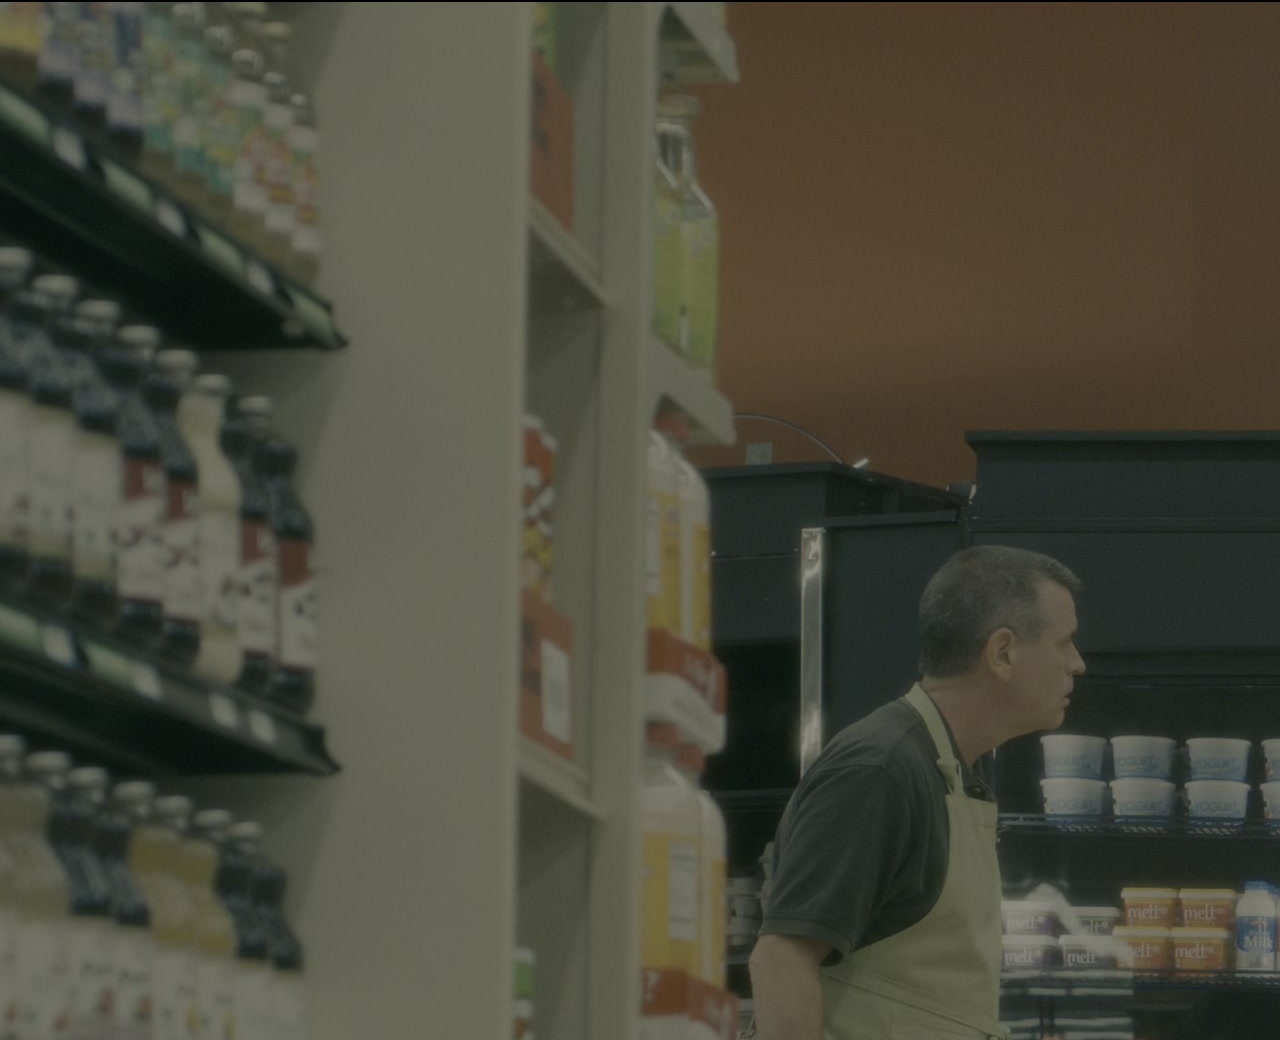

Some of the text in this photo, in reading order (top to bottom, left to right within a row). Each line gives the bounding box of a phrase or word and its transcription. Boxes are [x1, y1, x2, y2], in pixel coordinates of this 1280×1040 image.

[1128, 904, 1160, 920] melt
[1184, 904, 1216, 920] melt
[1245, 935, 1273, 950] Milk
[1005, 948, 1034, 964] melt
[1067, 949, 1097, 966] melt
[1175, 942, 1208, 960] melt
